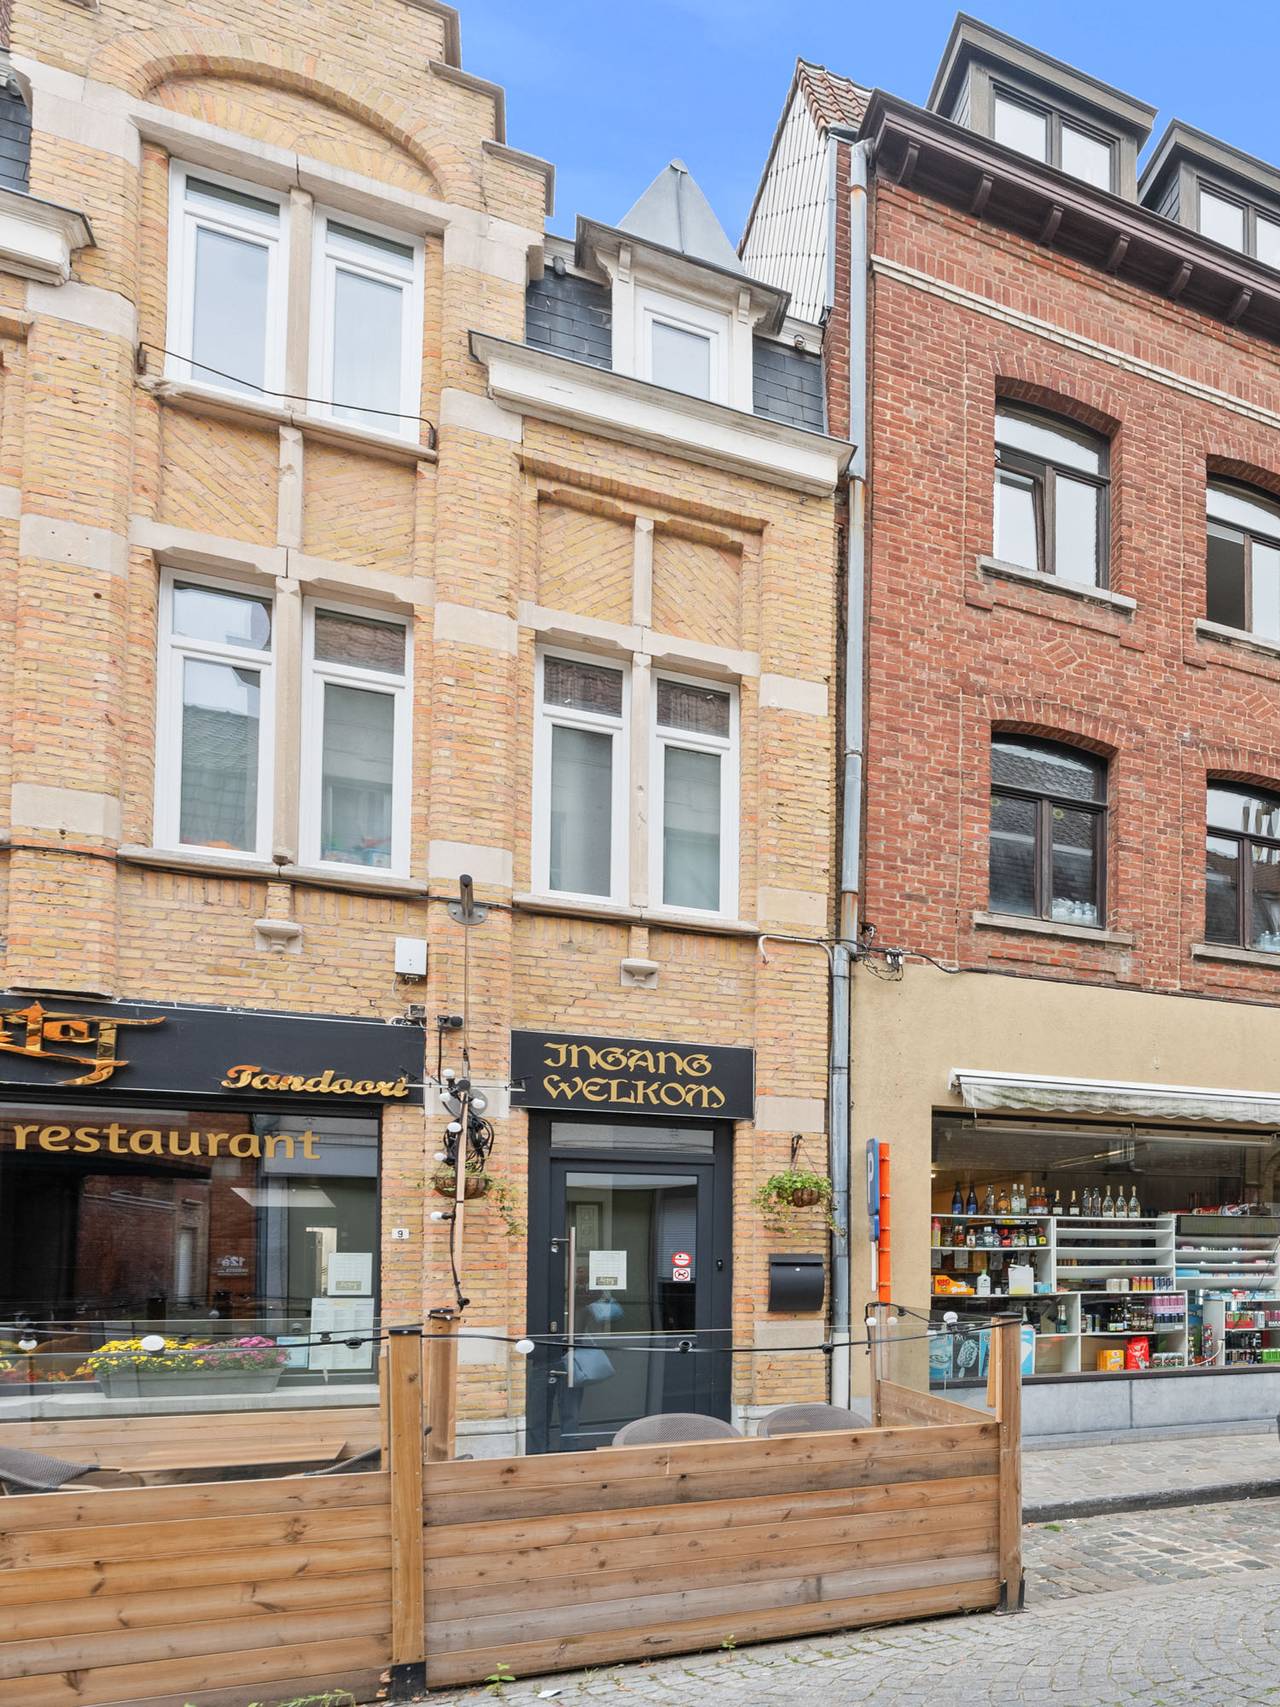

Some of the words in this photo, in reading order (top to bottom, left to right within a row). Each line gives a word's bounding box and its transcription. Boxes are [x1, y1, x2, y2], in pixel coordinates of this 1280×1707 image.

[543, 1042, 712, 1077] INGANG
[221, 1065, 409, 1098] Tandoori
[543, 1075, 726, 1109] WELKOM
[13, 1122, 321, 1160] restaurant
